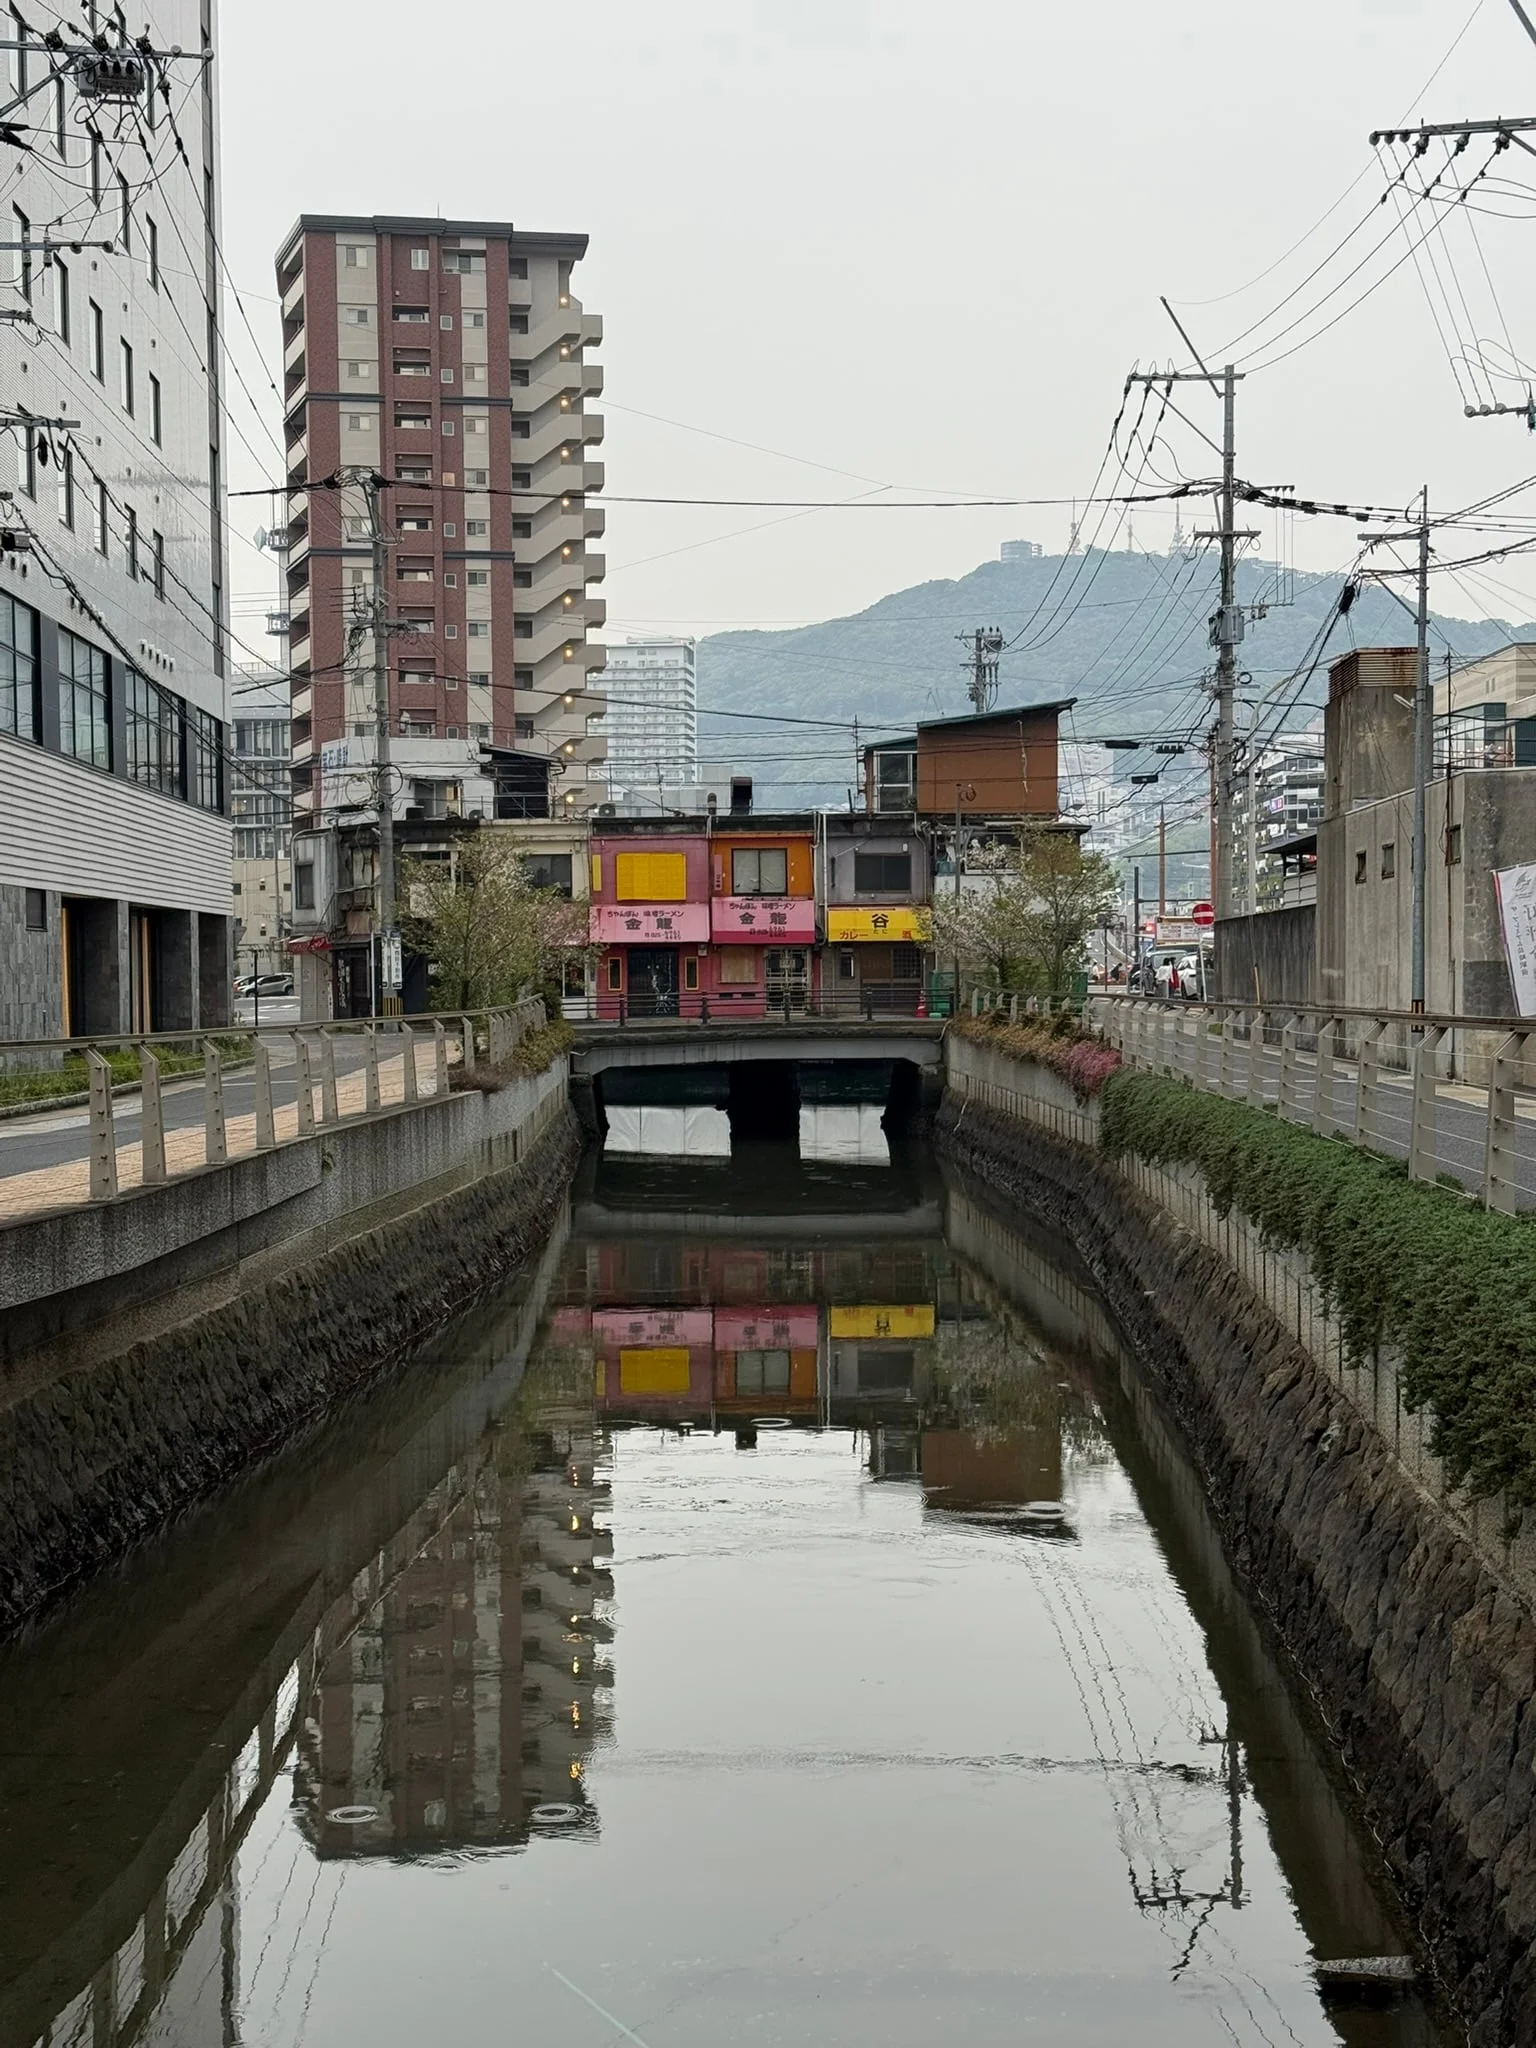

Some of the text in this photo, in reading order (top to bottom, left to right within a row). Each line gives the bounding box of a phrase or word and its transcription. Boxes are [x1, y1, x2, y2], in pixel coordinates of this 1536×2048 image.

[871, 913, 890, 929] 谷
[840, 930, 869, 940] カレー
